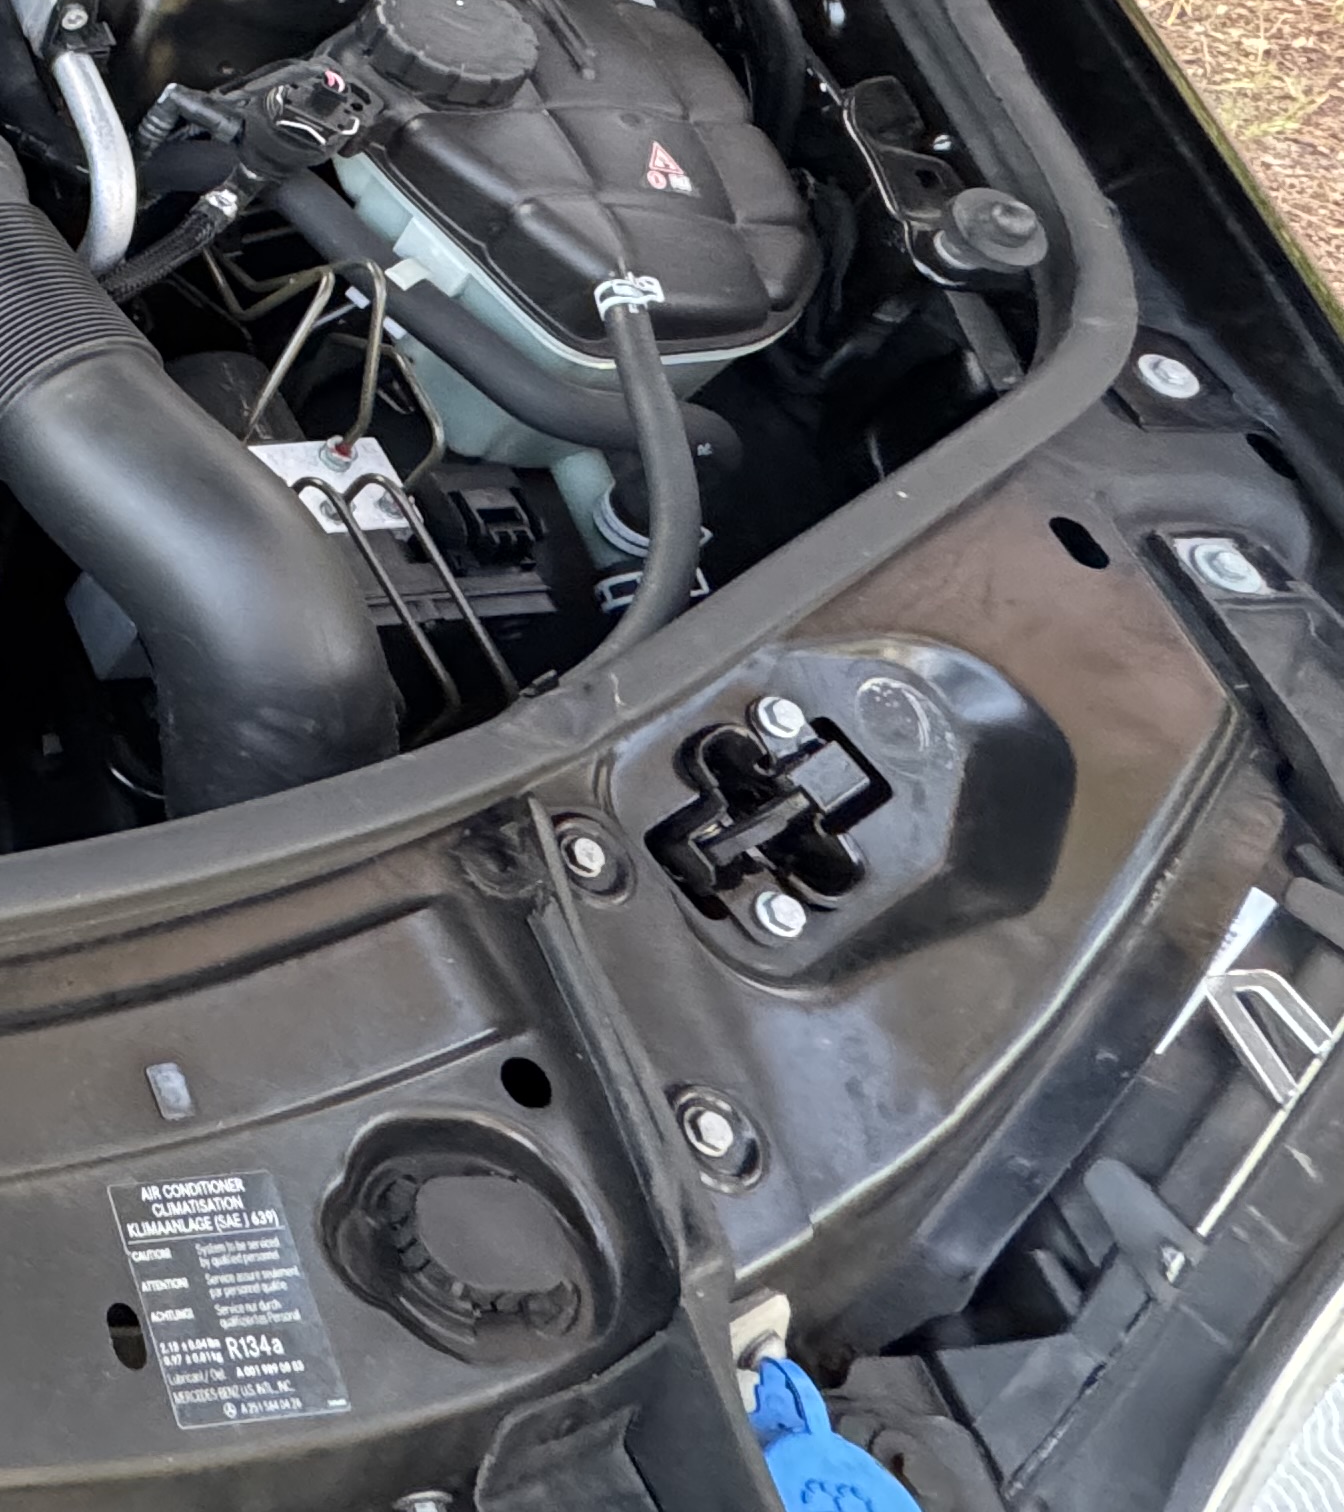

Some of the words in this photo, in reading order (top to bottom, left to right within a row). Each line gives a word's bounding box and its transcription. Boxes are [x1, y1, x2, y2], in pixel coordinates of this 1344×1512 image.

[141, 1186, 162, 1202] AIR
[162, 1177, 246, 1199] CONDITIONER
[151, 1194, 245, 1218] CLIMATISATION
[127, 1216, 213, 1238] KLIMAANLAGE
[214, 1212, 242, 1233] (SAE
[251, 1209, 280, 1227] 639)
[225, 1334, 285, 1360] R134a
